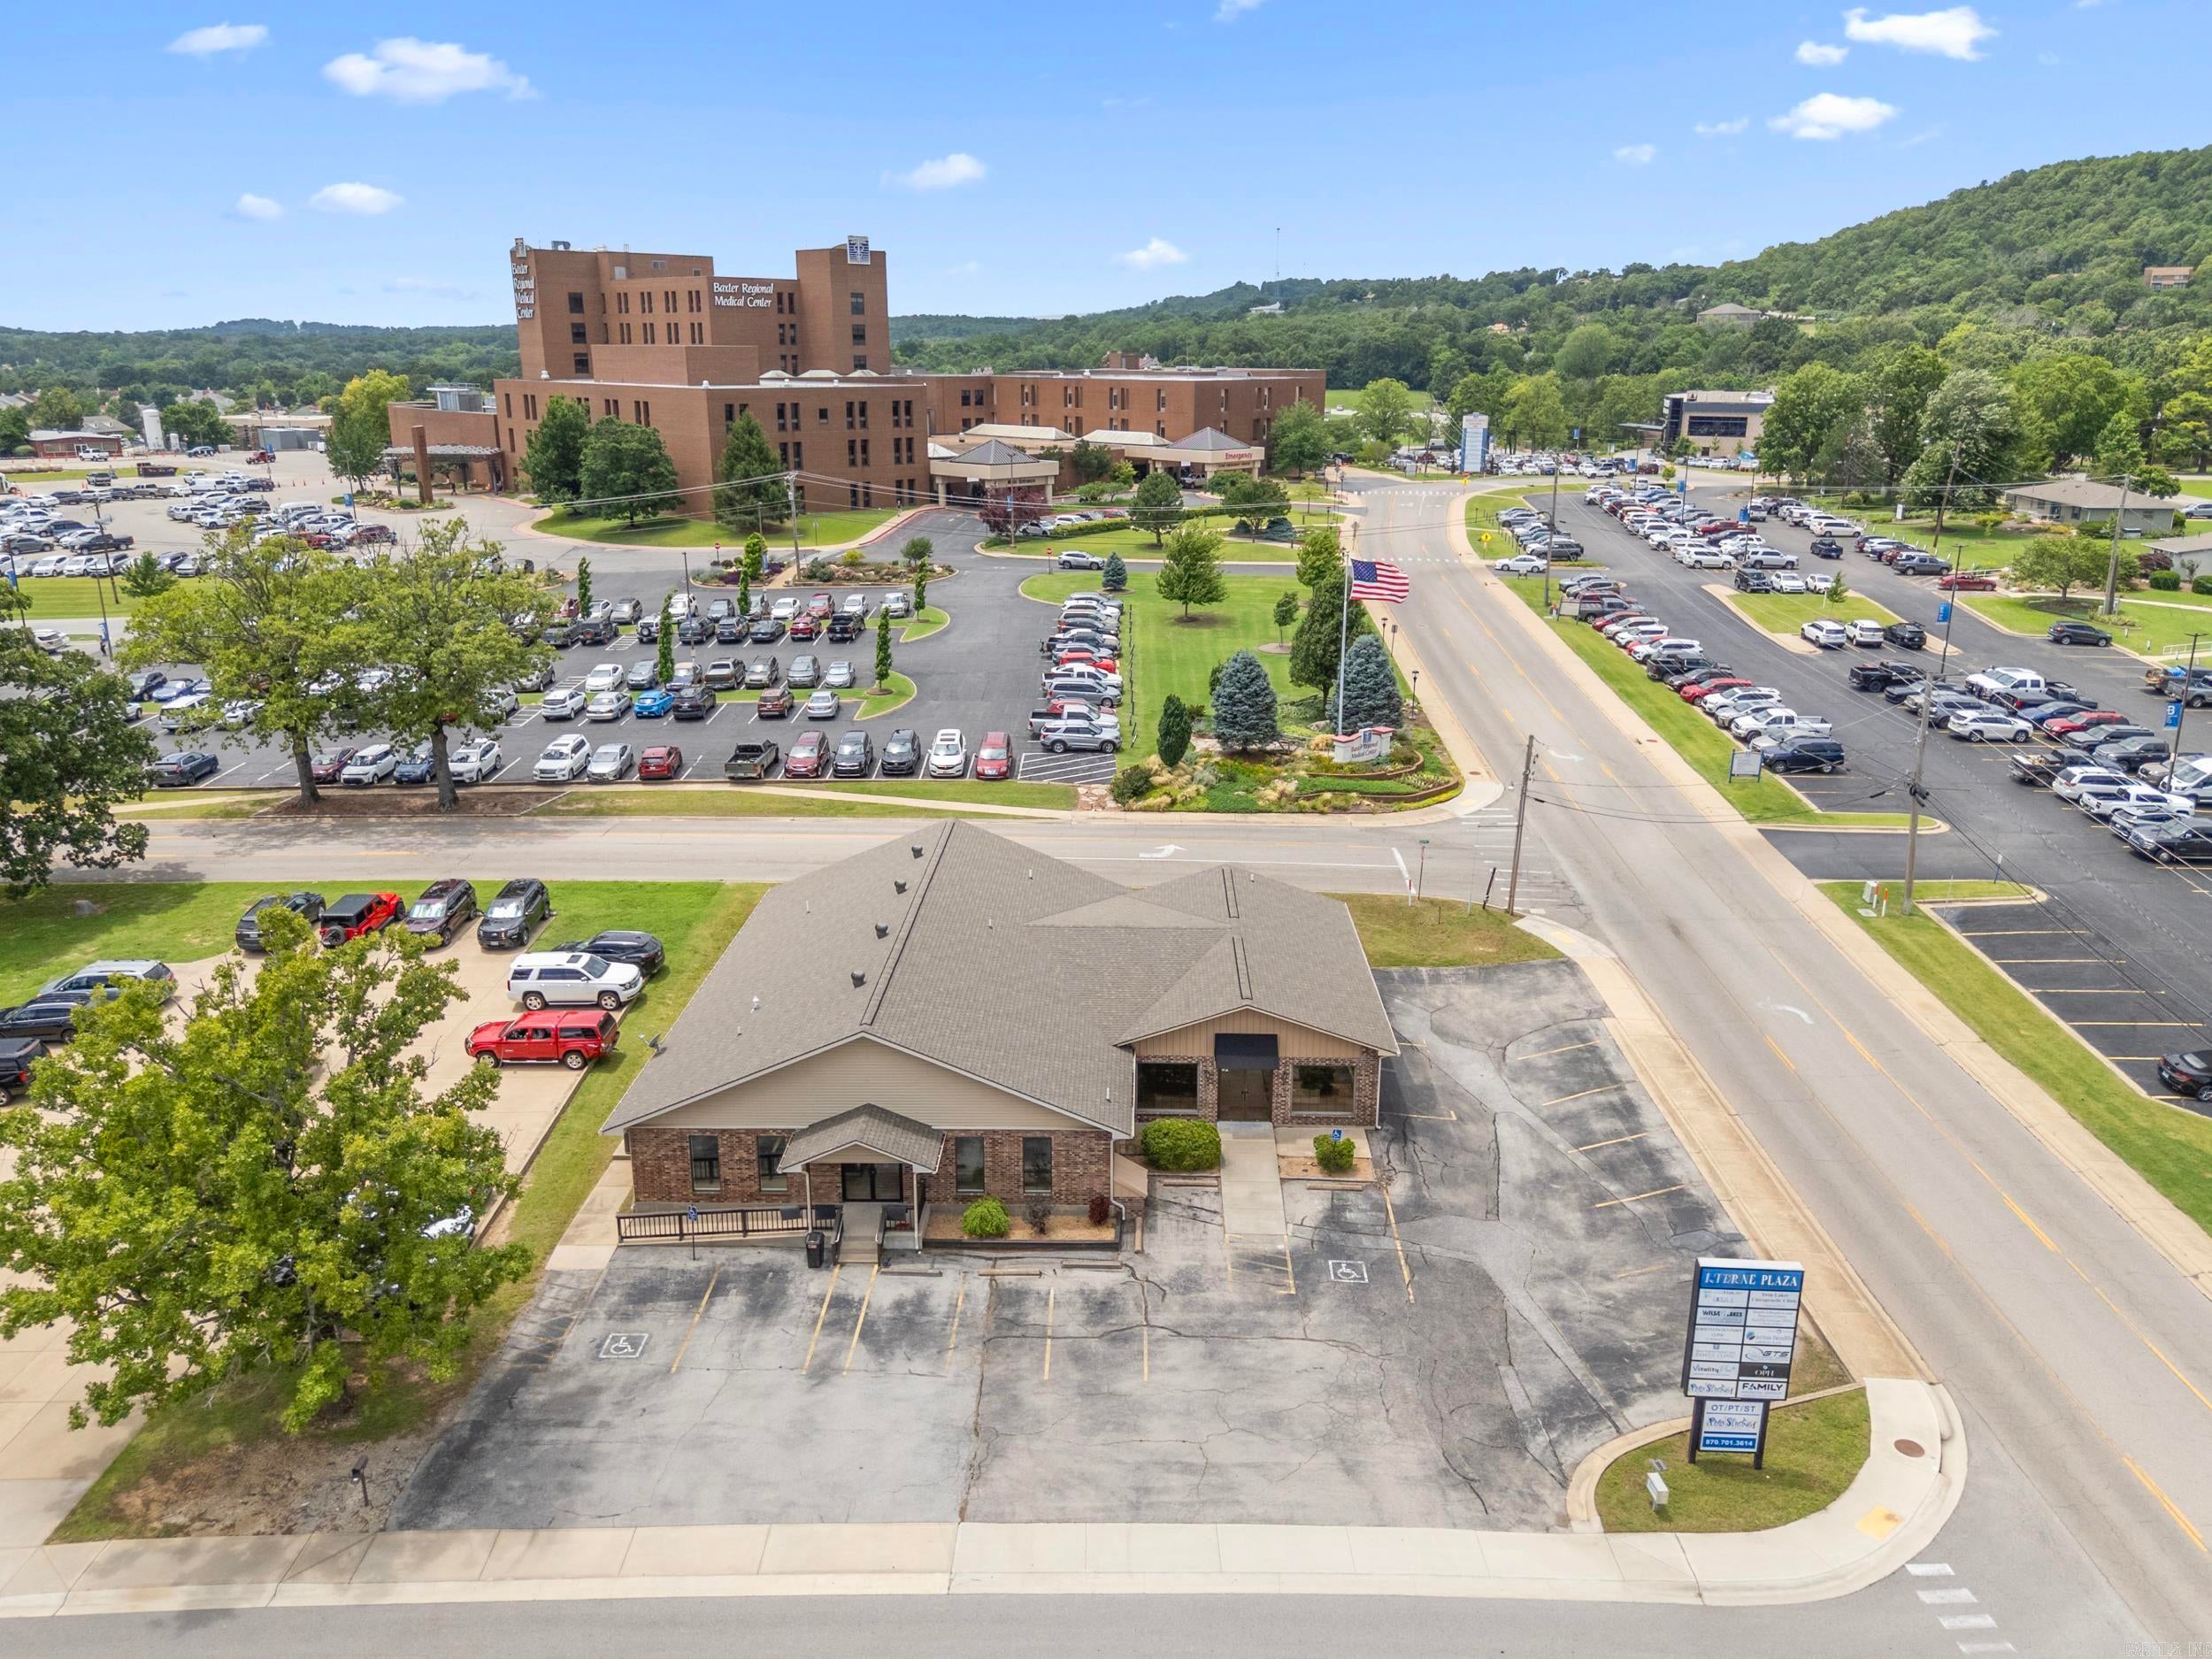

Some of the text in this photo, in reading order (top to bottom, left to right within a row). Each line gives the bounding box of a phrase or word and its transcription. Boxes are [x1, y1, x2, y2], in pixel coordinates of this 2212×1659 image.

[512, 263, 528, 274] Baxter
[513, 276, 534, 291] Regional
[713, 282, 774, 296] Baxter Regional
[515, 290, 534, 303] Medical
[714, 296, 772, 308] Medical Center
[517, 306, 534, 319] Center
[2167, 705, 2176, 716] B
[1761, 1275, 1798, 1286] PLAZA
[1693, 1363, 1719, 1373] Vitality
